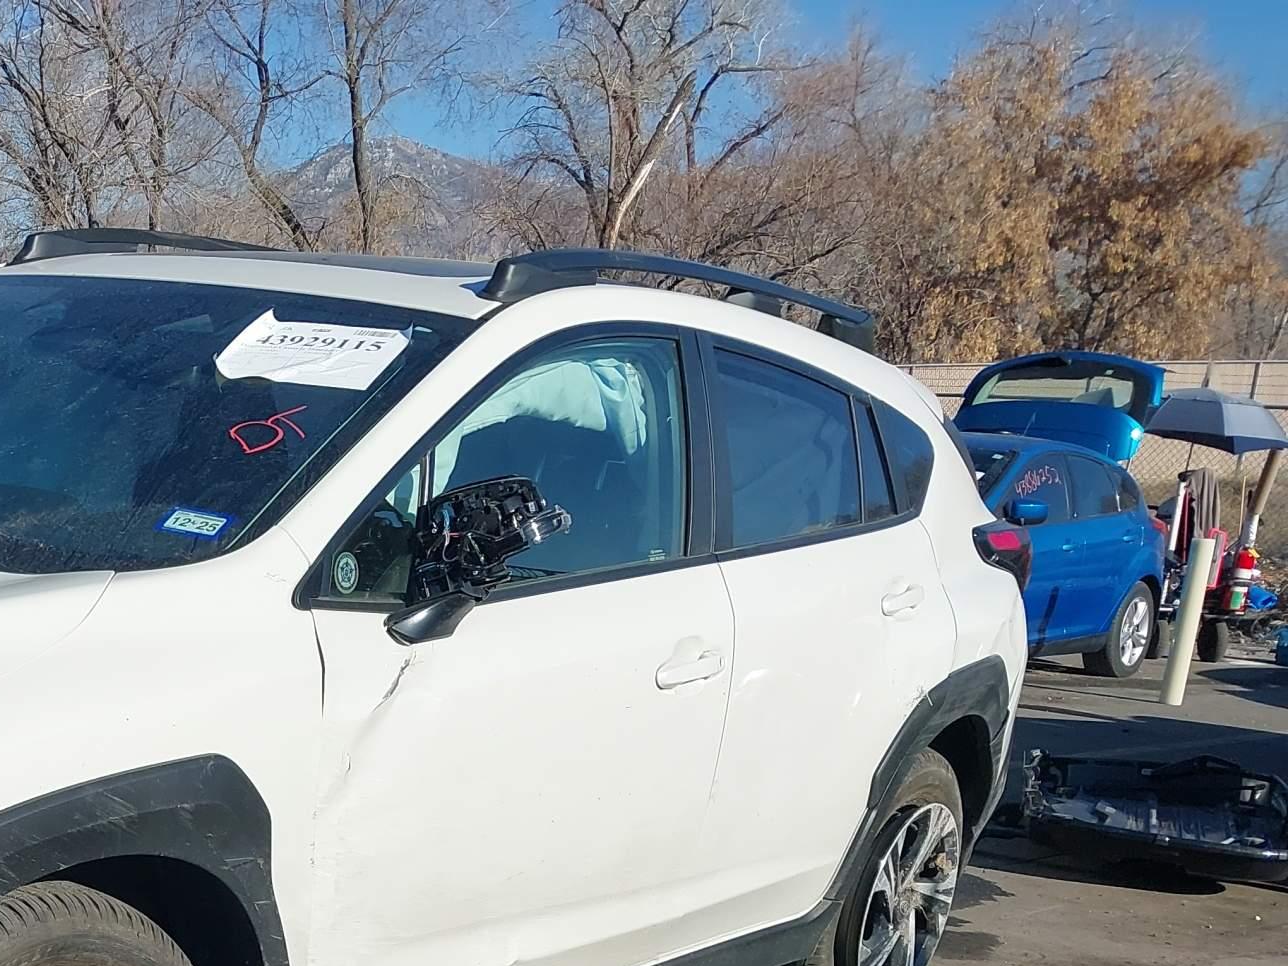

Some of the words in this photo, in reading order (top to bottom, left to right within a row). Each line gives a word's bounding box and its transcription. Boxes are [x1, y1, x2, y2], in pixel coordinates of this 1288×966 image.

[255, 334, 388, 352] 43929115
[172, 516, 189, 527] 12
[195, 521, 220, 532] 25
